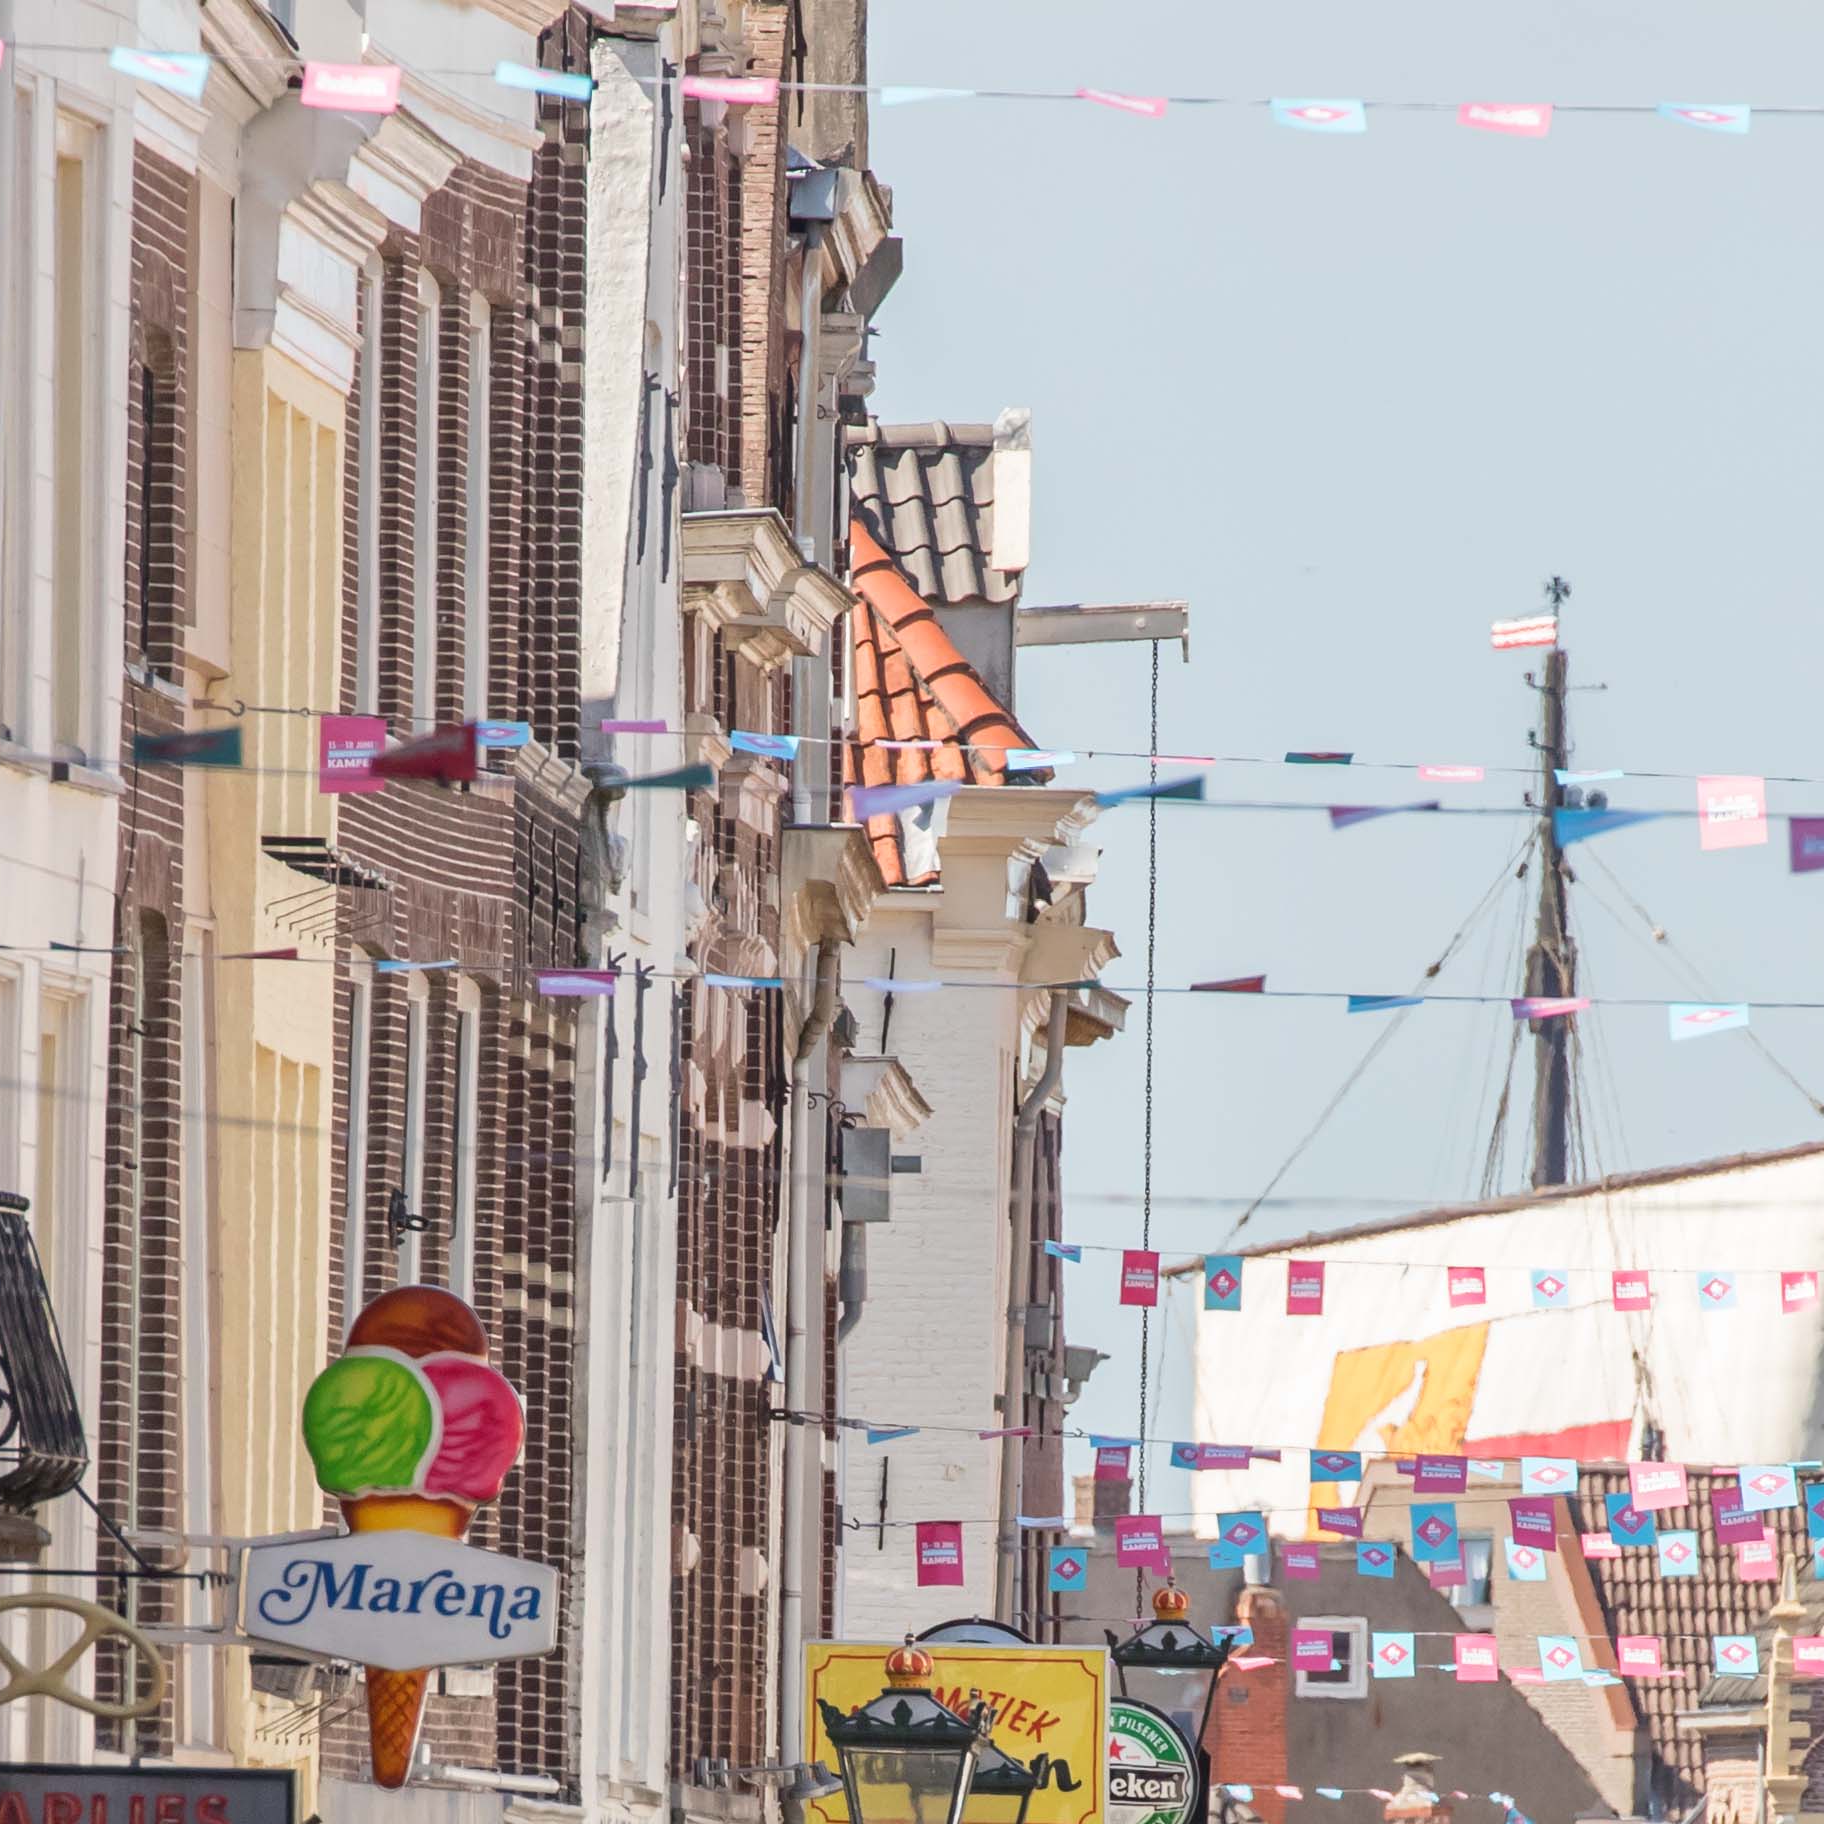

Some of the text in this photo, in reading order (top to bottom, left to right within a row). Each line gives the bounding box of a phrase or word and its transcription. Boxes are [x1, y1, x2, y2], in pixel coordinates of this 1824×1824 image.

[327, 758, 373, 769] KAMPE
[259, 1559, 541, 1640] Marena
[1118, 1715, 1170, 1755] PILSENER
[1110, 1772, 1178, 1799] eken
